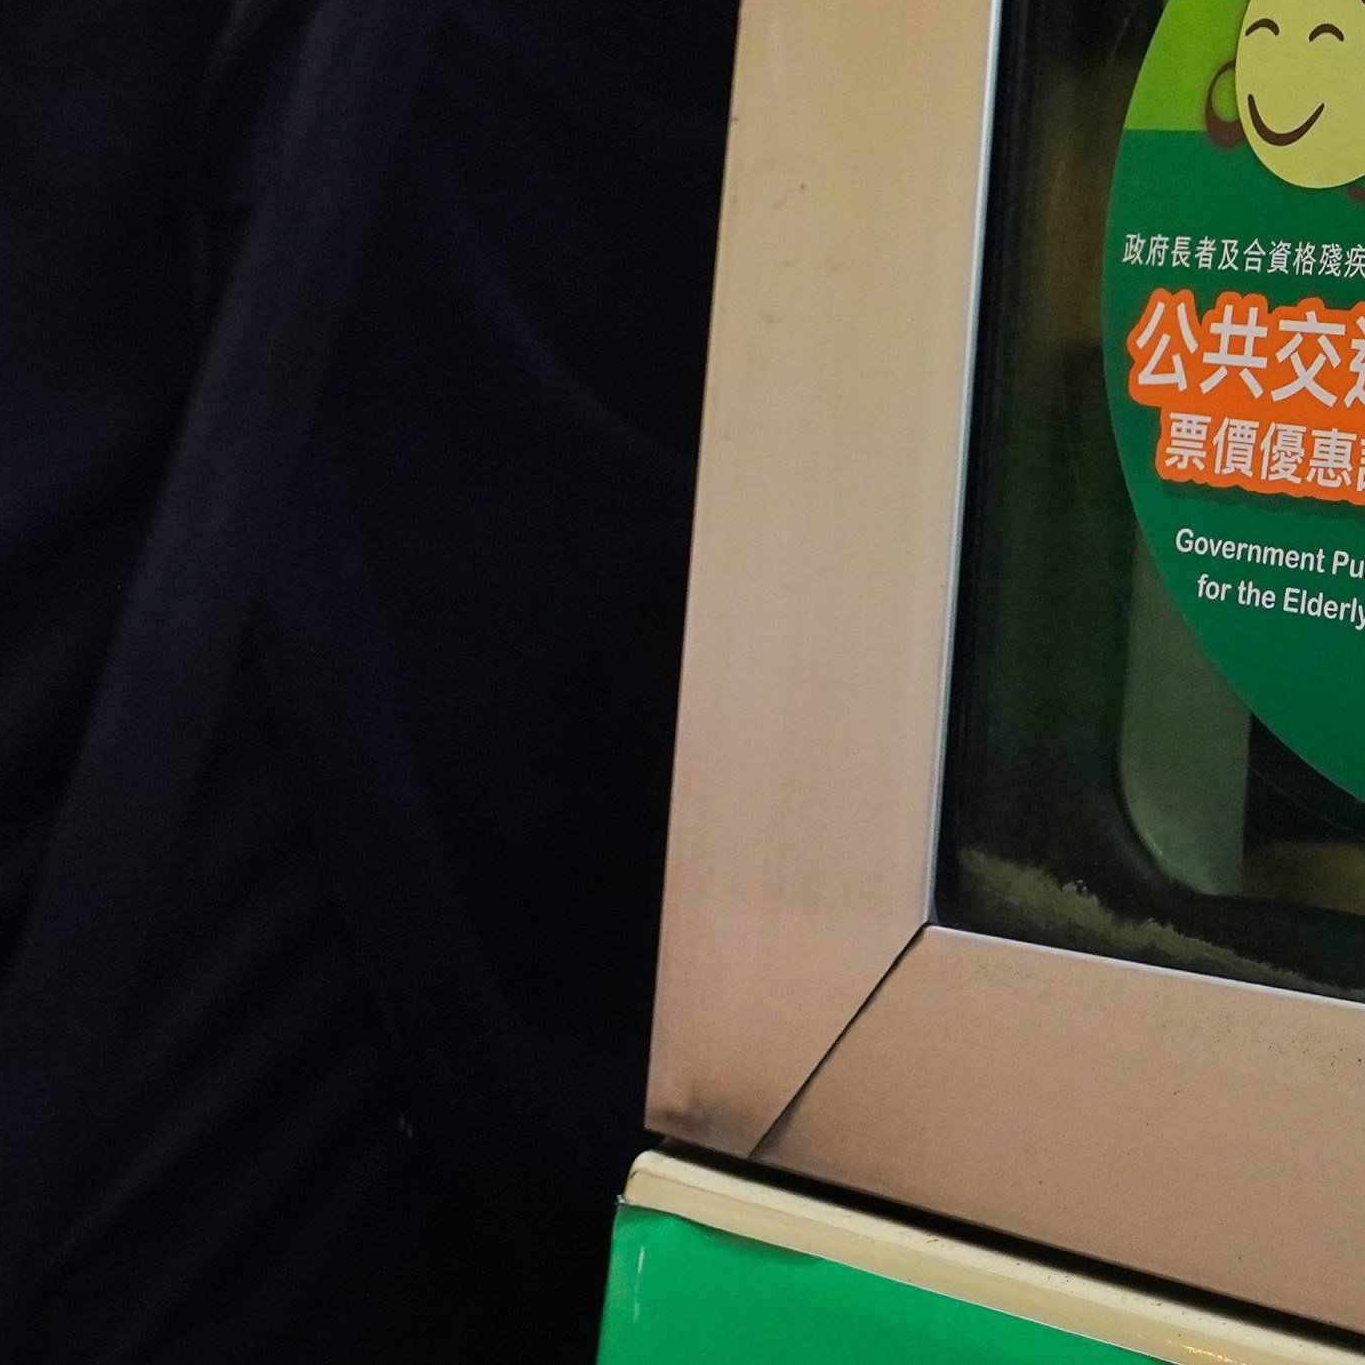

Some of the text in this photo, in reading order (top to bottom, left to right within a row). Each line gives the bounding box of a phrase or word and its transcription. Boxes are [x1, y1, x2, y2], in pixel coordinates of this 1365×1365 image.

[1175, 527, 1326, 574] Government
[1197, 573, 1232, 601] for
[1237, 580, 1276, 609] the
